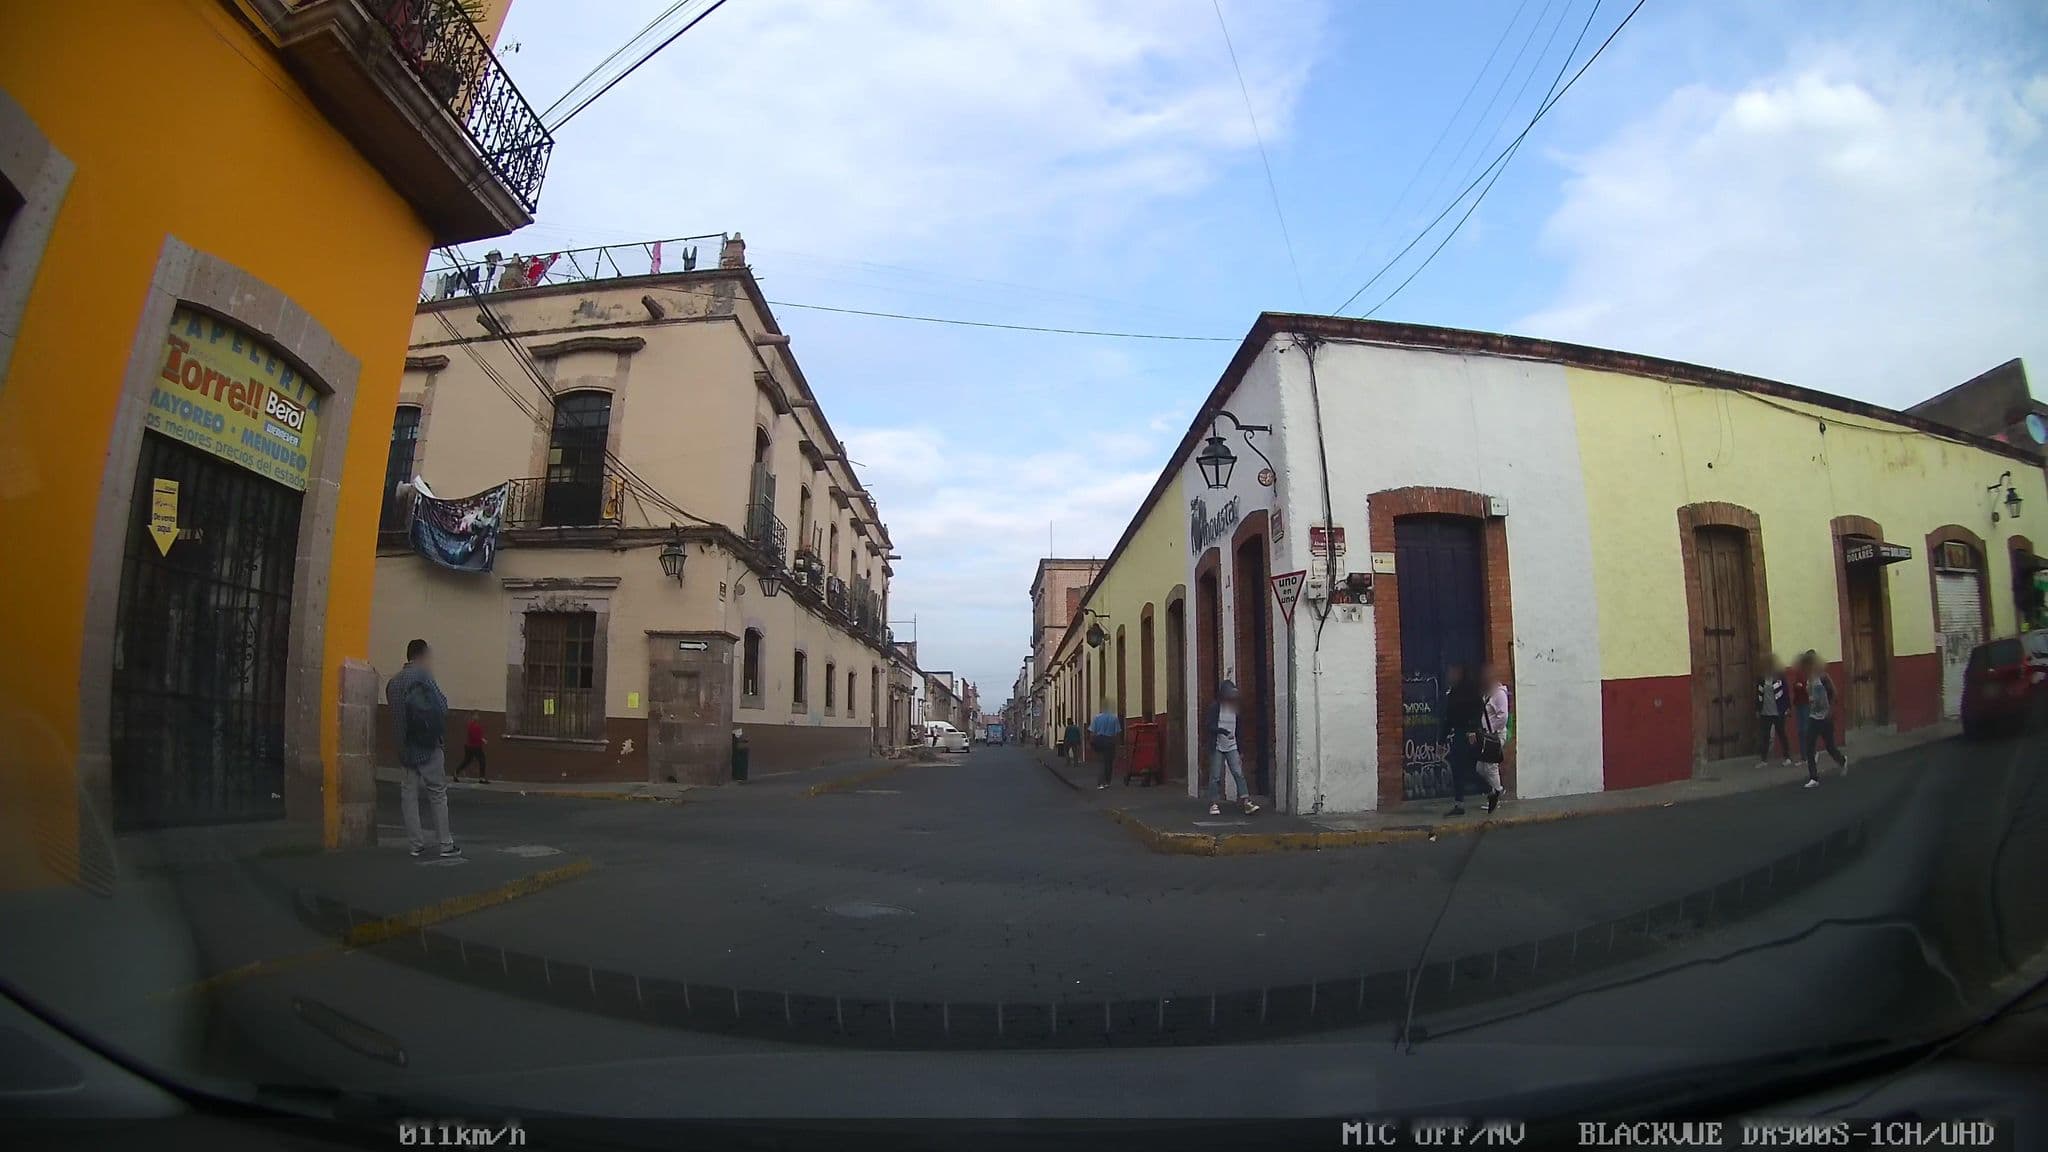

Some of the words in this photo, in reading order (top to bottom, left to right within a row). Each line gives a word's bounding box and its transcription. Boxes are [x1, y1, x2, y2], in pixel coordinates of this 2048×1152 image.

[150, 387, 225, 434] MAYOREO
[241, 428, 307, 473] MENUDEO
[266, 391, 306, 431] Berol
[165, 419, 211, 449] mejores
[216, 440, 255, 467] precios
[256, 456, 272, 474] del
[274, 465, 306, 489] estado
[1279, 576, 1297, 587] uno
[1281, 596, 1295, 604] uno
